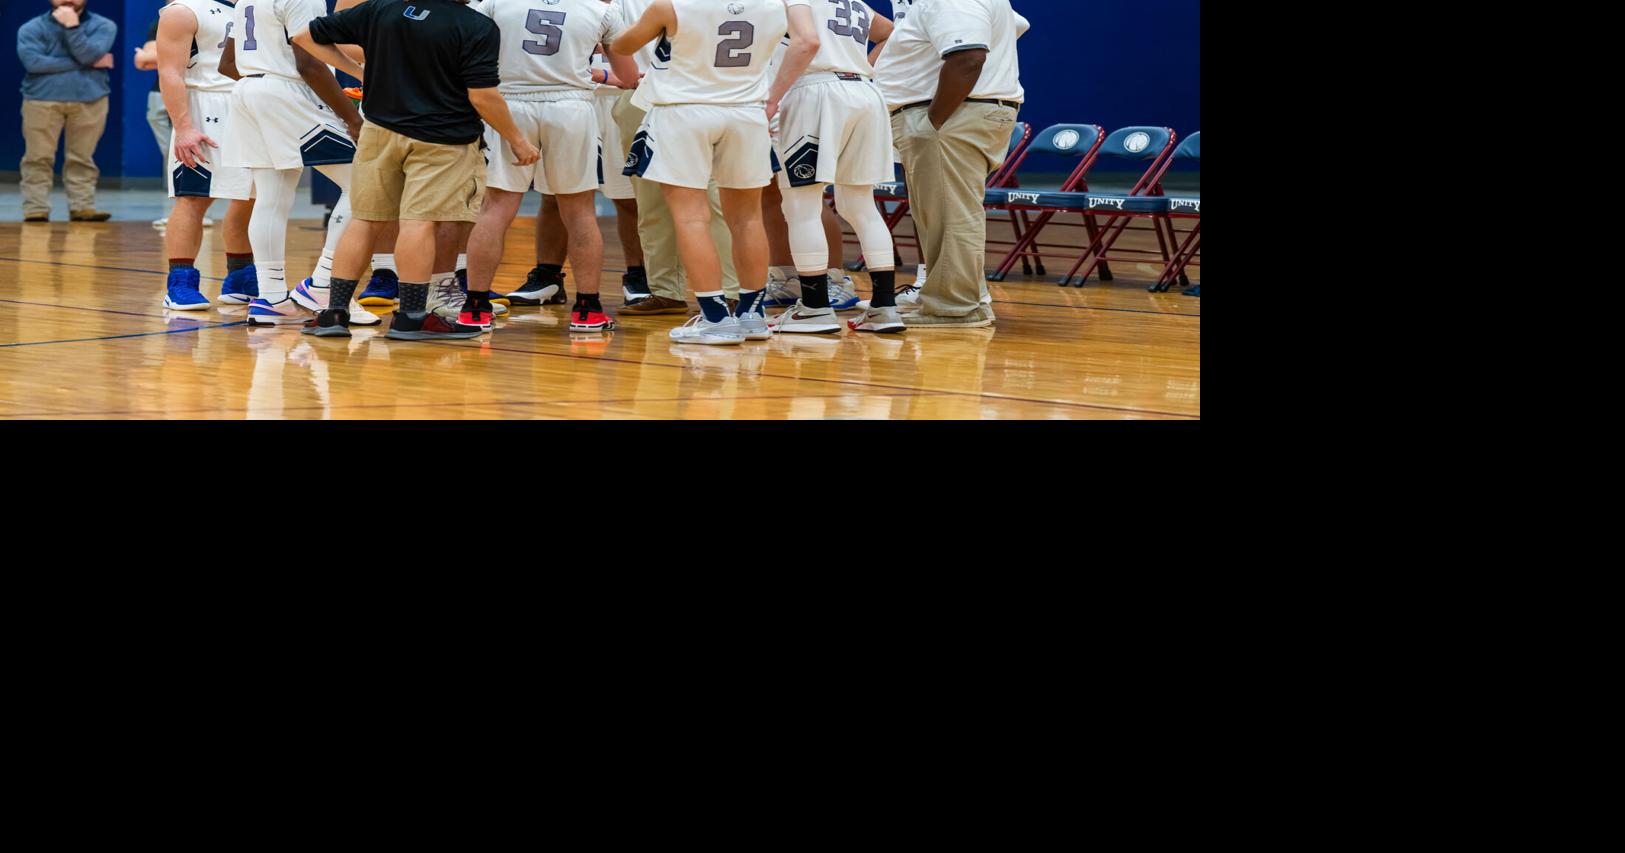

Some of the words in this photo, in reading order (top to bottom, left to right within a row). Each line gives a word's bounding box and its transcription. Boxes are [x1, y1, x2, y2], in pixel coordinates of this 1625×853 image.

[243, 5, 257, 50] 1
[522, 8, 566, 56] 5
[714, 20, 754, 68] 2
[828, 0, 870, 45] 33
[1007, 192, 1040, 204] UNITY
[1088, 197, 1125, 210] UNITY
[1170, 199, 1200, 212] UNITY
